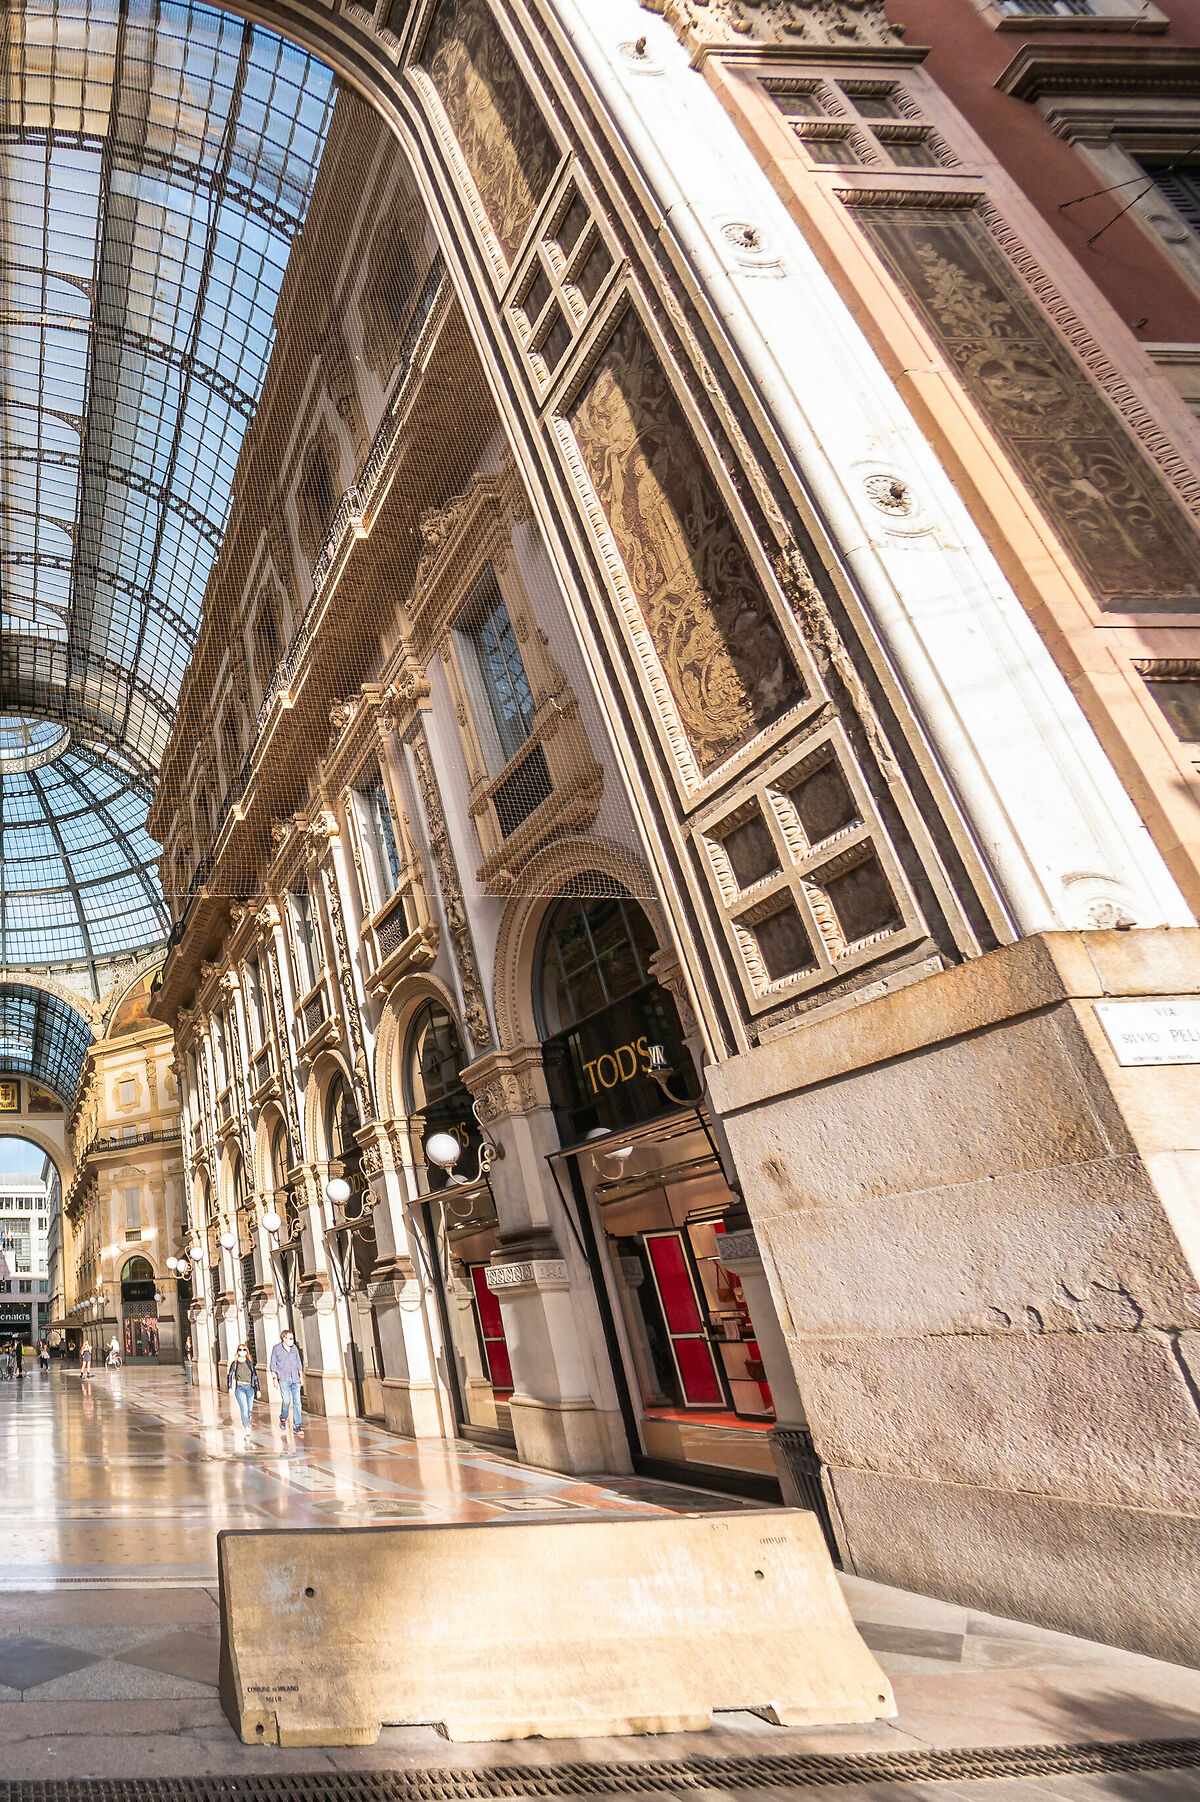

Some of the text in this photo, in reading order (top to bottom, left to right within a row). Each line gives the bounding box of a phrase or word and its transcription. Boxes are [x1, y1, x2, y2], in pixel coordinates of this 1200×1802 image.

[1153, 1007, 1176, 1017] VIA
[1121, 1033, 1161, 1044] SILVIO
[582, 1035, 653, 1095] TOD'S
